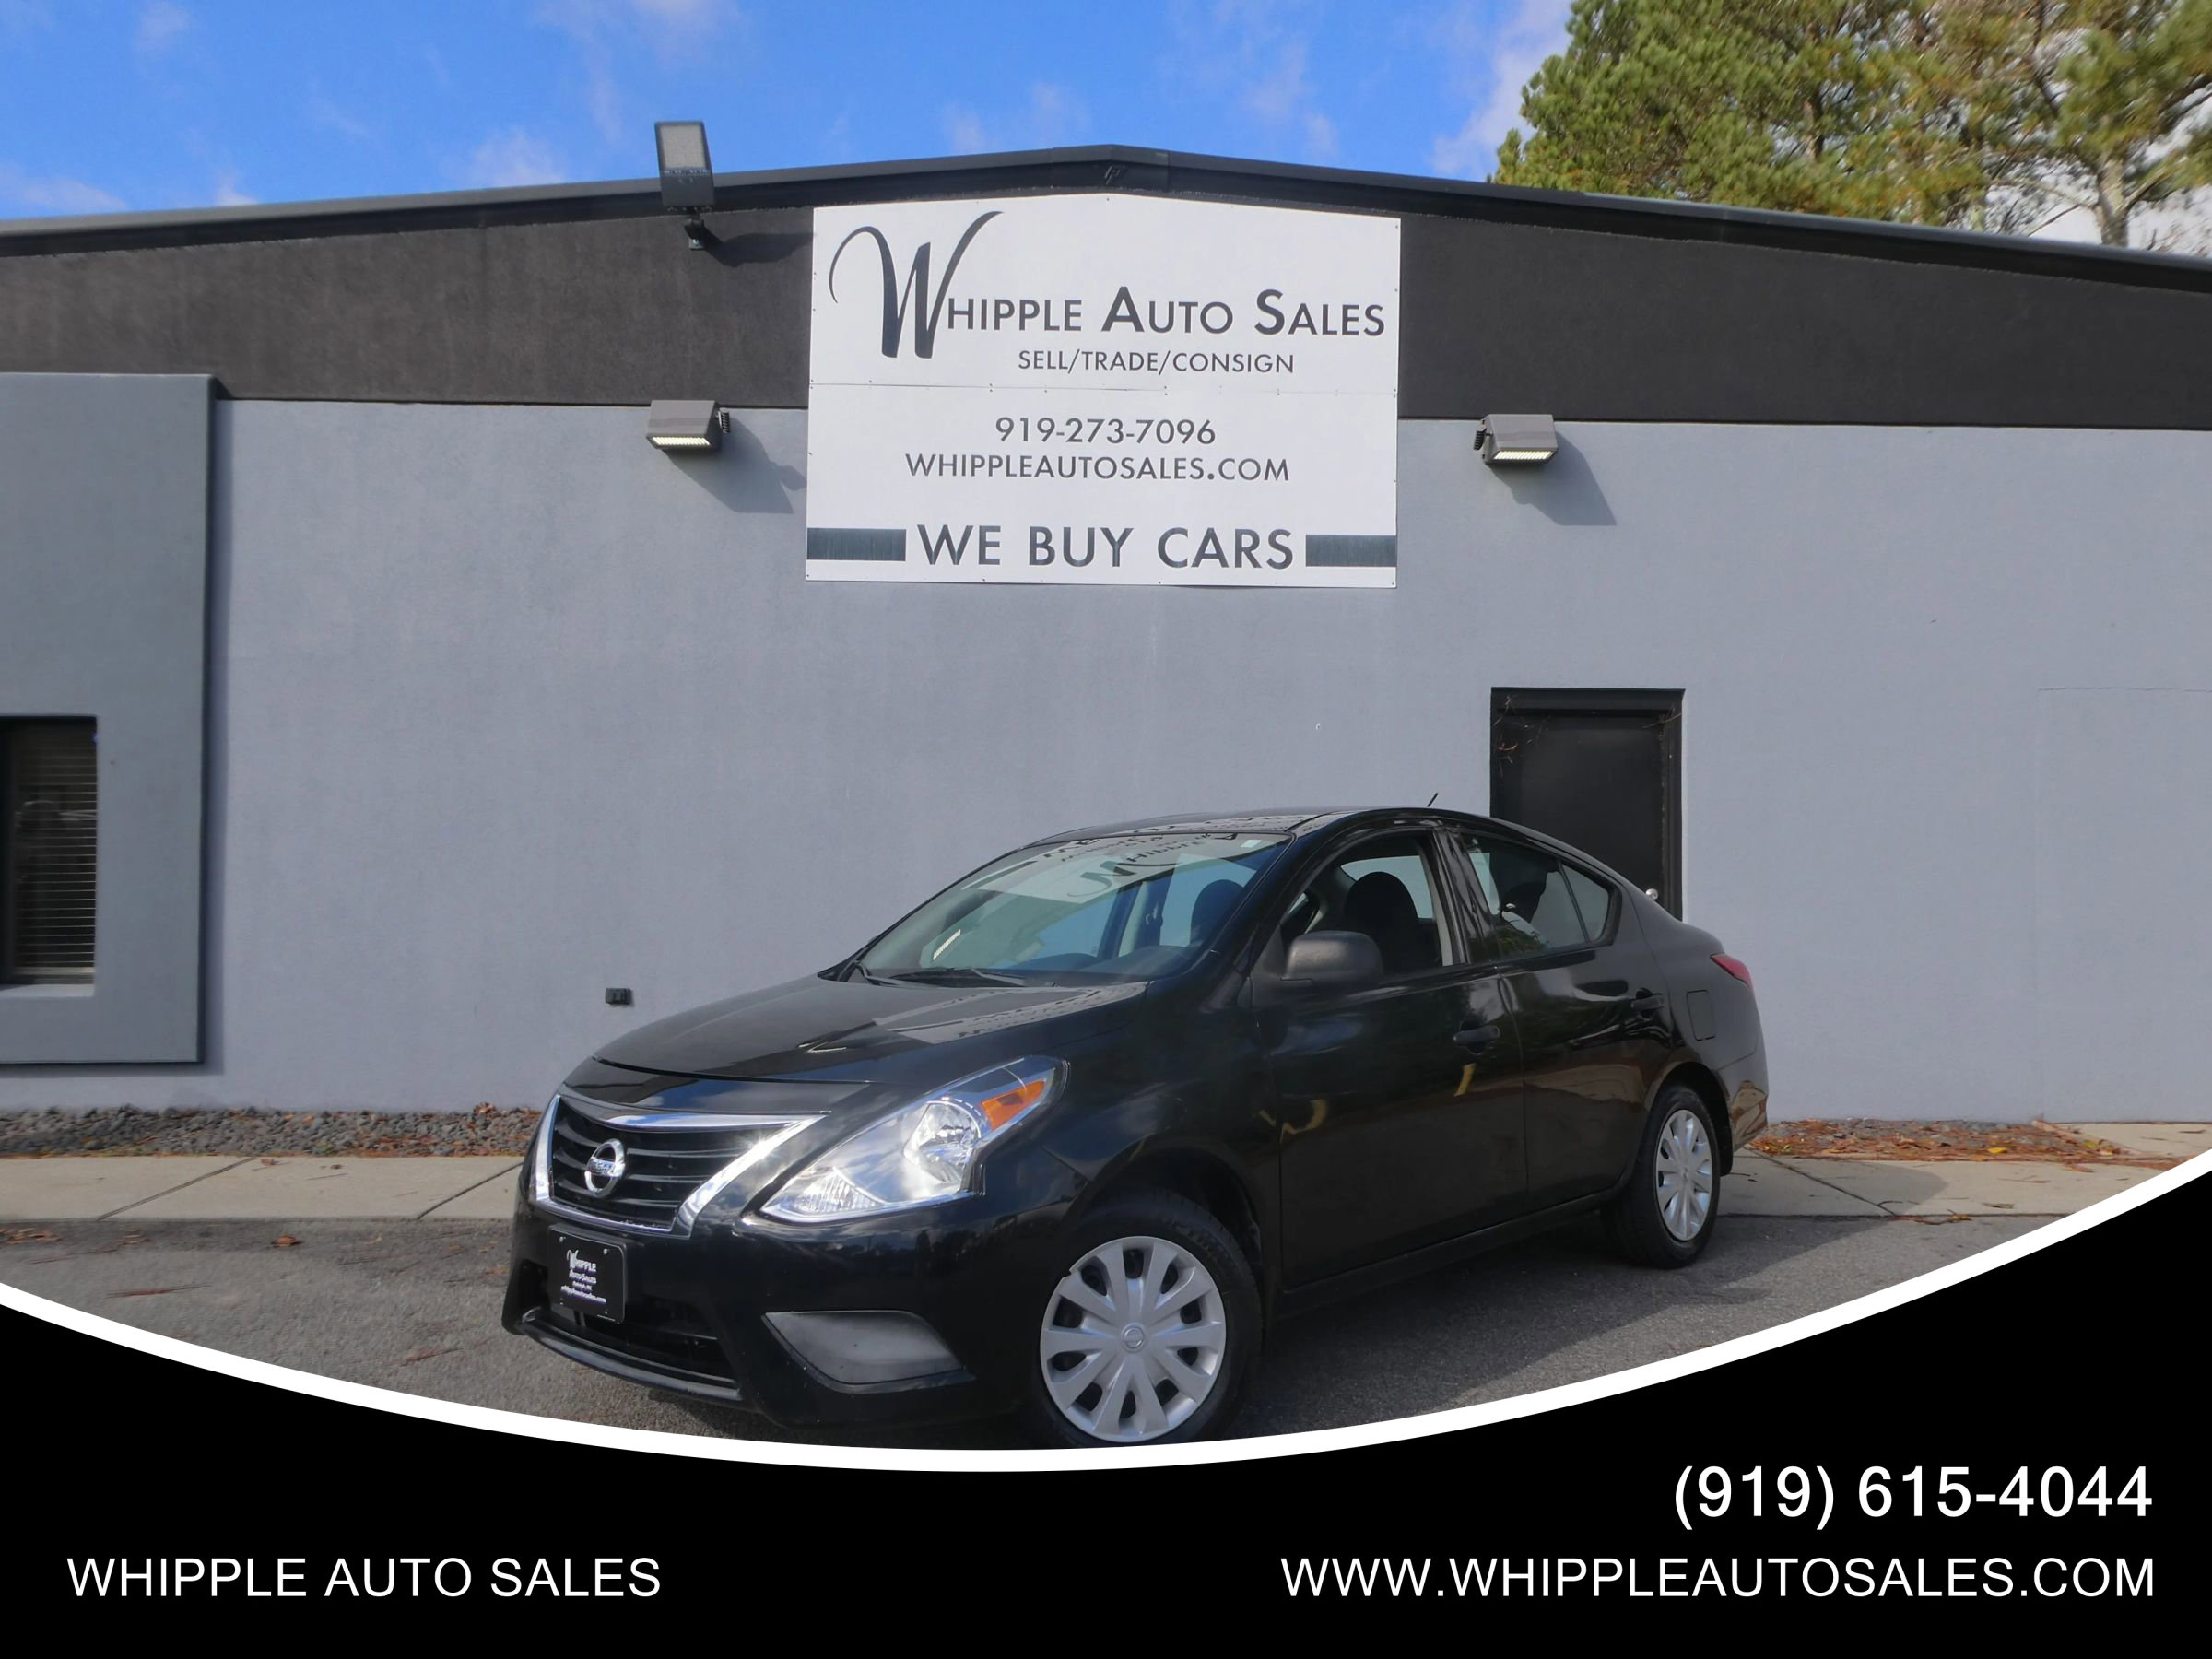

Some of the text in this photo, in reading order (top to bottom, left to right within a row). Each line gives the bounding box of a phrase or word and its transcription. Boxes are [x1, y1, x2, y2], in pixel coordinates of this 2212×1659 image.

[830, 211, 1385, 359] WHIPPLE AUTO SALES
[1018, 348, 1294, 375] SELL/TRADE/CONSIGN
[996, 418, 1216, 444] 919-273-7096
[906, 453, 1289, 481] WHIPPLEAUTOSALES.COM
[917, 524, 1293, 570] WE BUY CARS
